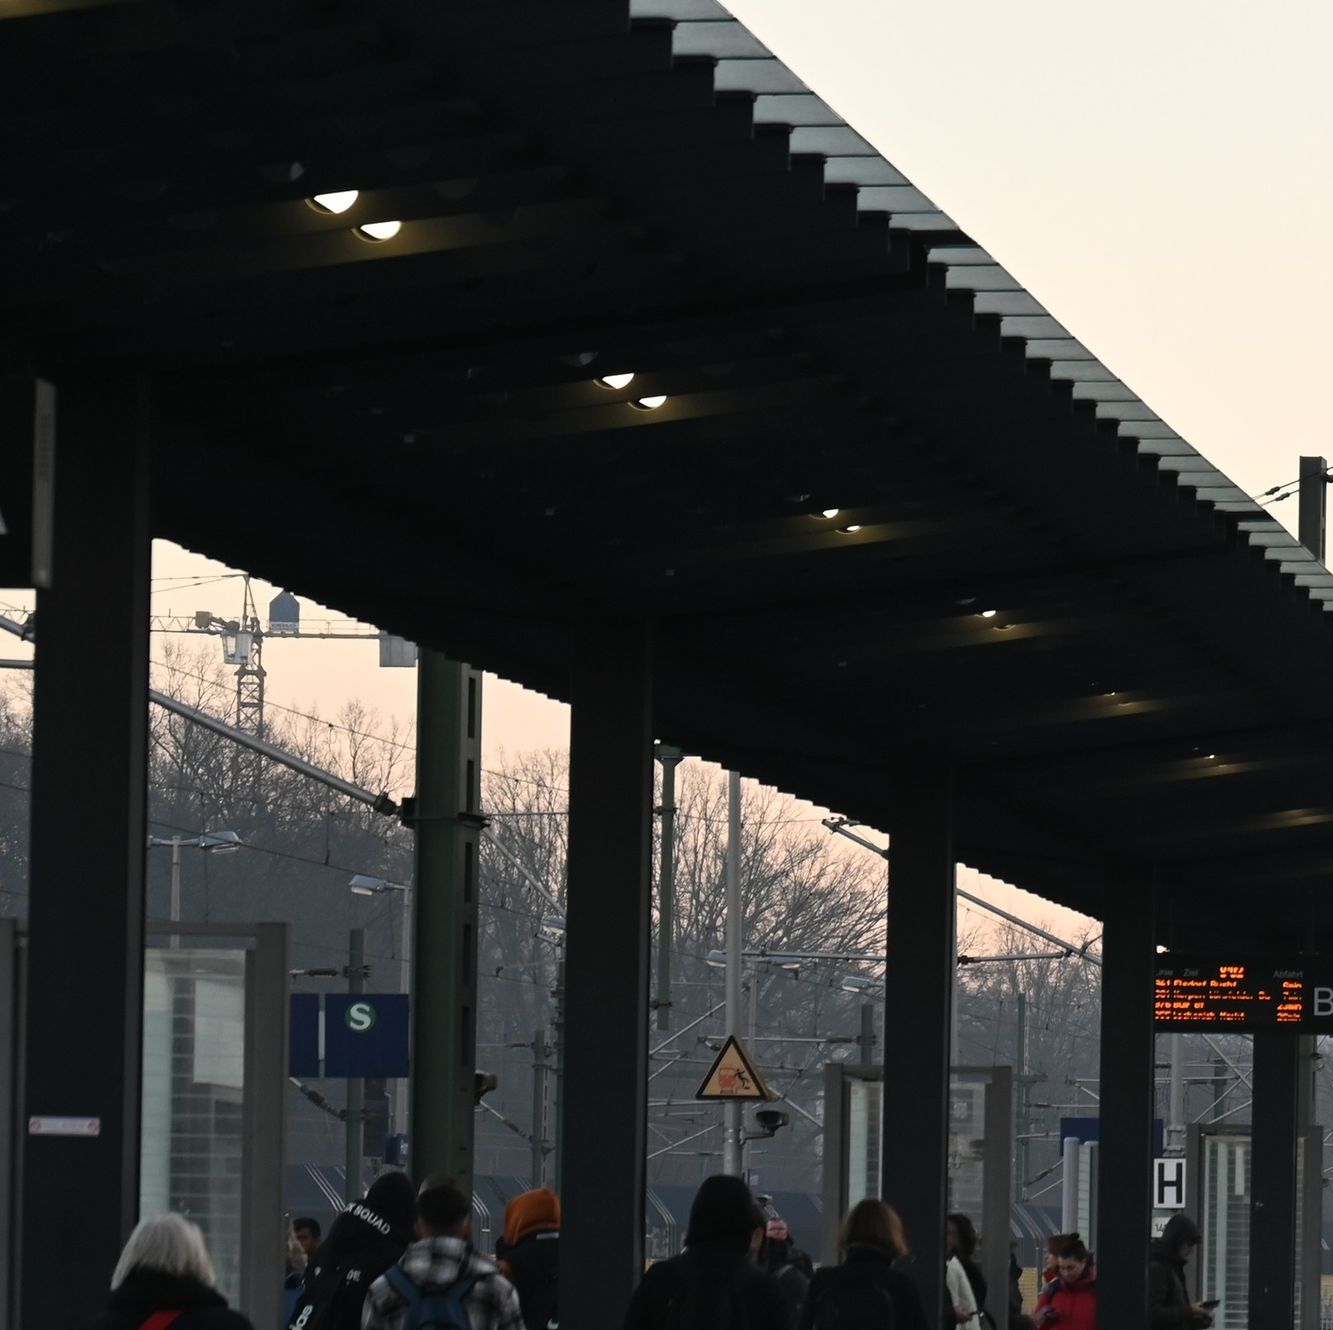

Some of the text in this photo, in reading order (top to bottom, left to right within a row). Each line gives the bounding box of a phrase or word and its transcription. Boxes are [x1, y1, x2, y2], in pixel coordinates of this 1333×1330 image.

[350, 1003, 371, 1030] S
[1158, 1162, 1183, 1204] H
[353, 1204, 391, 1235] SQUAD
